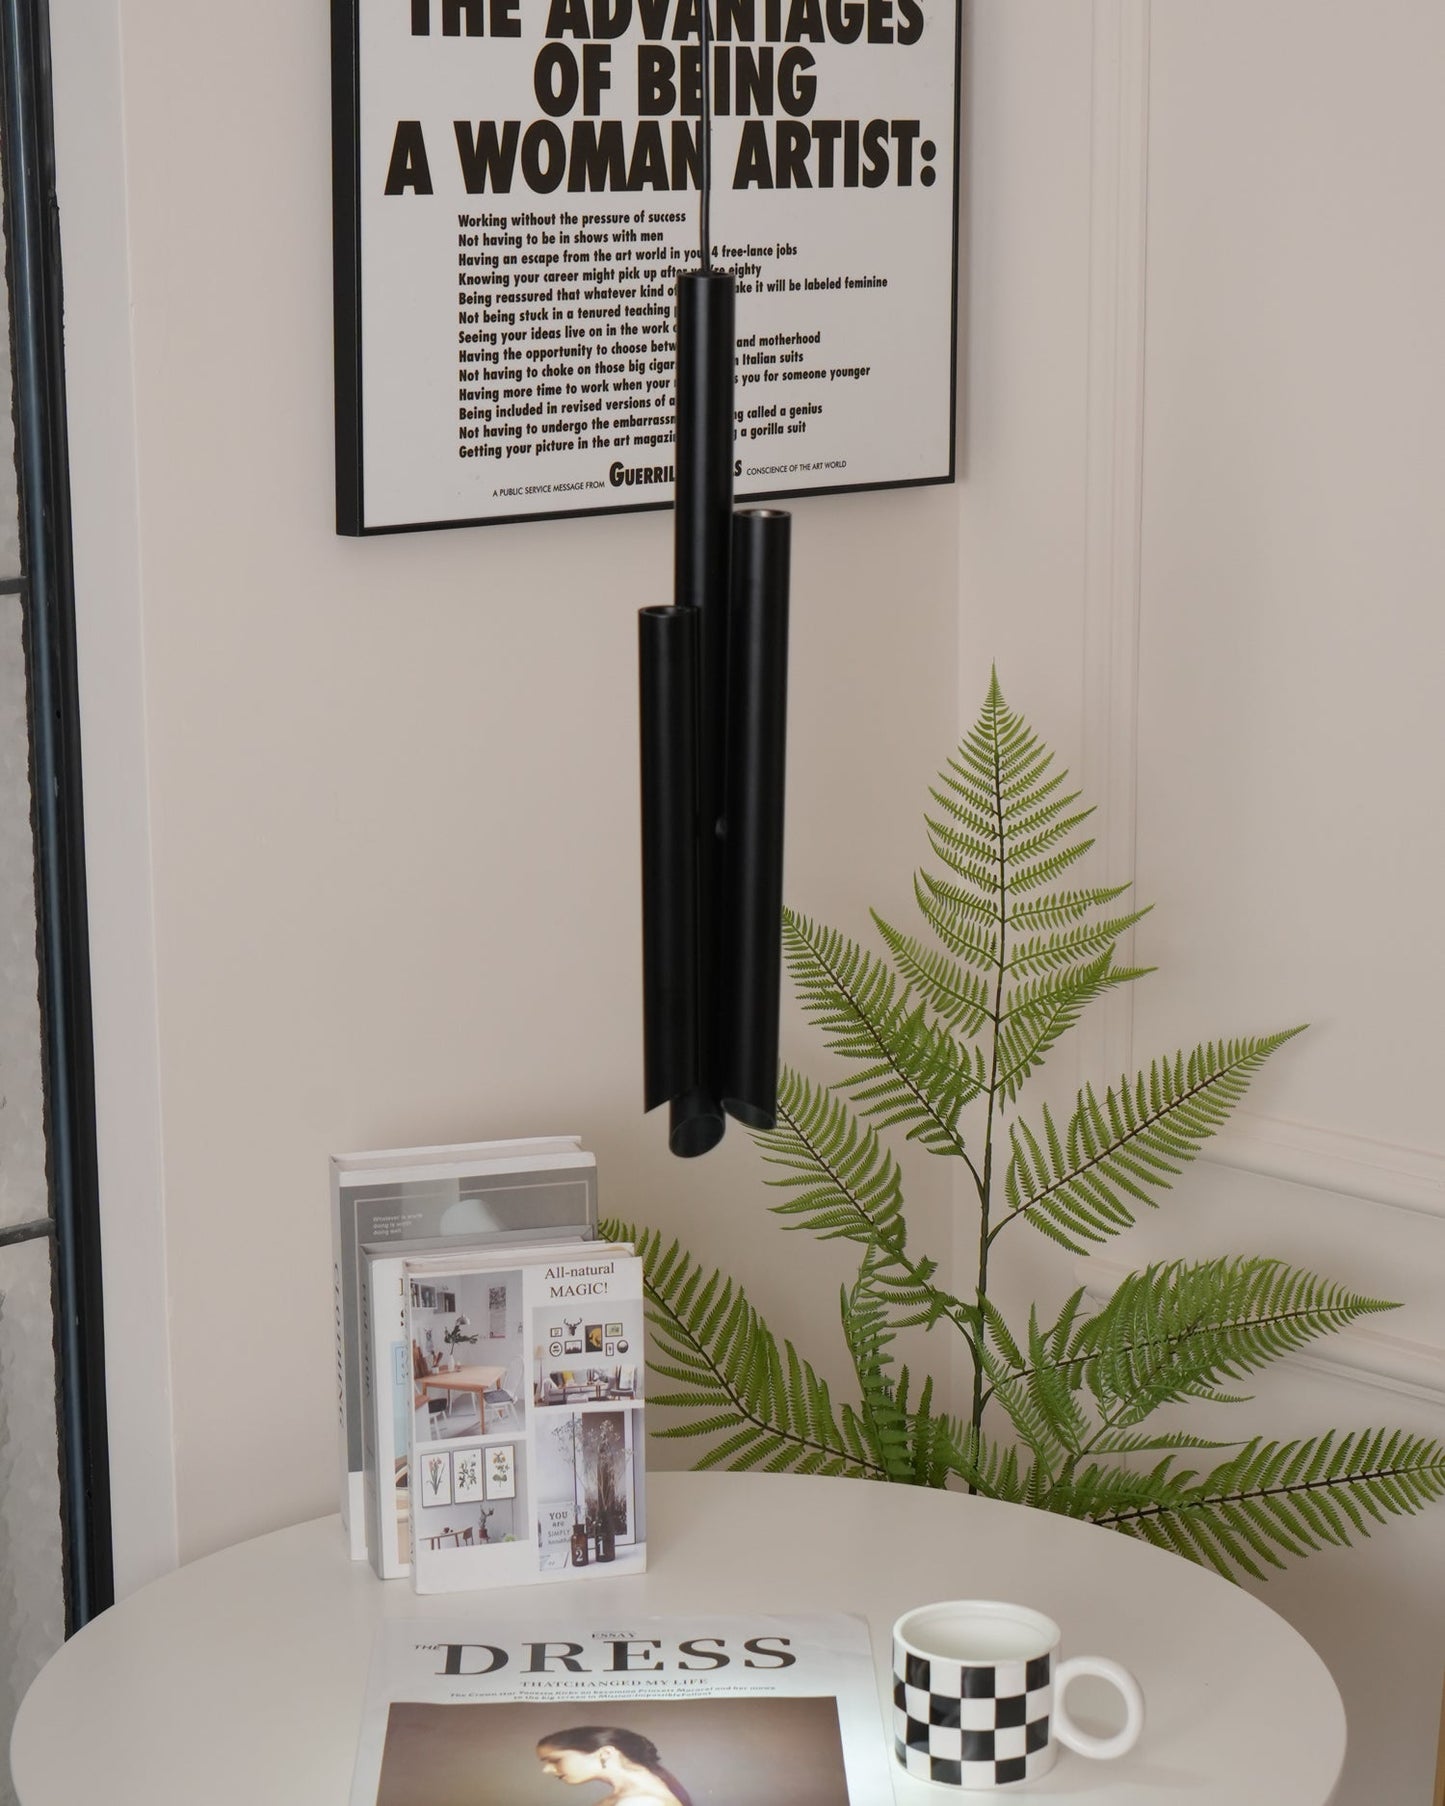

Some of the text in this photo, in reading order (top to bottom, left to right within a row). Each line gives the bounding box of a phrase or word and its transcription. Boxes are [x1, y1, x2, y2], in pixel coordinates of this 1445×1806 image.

[534, 42, 817, 117] OF BEING
[384, 119, 936, 196] A WOMAN ARTIST:
[458, 210, 686, 230] Working without the pressure of success
[459, 229, 663, 249] Not having to be in shows with men
[459, 252, 499, 269] Having
[503, 256, 517, 264] an
[521, 254, 559, 267] escape
[563, 250, 589, 262] from
[594, 249, 611, 261] the
[616, 250, 632, 261] art
[636, 247, 666, 260] world
[671, 247, 680, 259] in
[712, 246, 718, 257] 4
[722, 244, 773, 257] free-lance
[777, 243, 797, 259] jobs
[459, 271, 509, 287] Knowing
[514, 274, 539, 287] your
[544, 273, 578, 282] career
[583, 268, 615, 284] might
[619, 267, 640, 283] pick
[644, 270, 657, 282] up
[660, 265, 687, 278] aft
[729, 263, 762, 278] eighty
[459, 291, 491, 307] Being
[496, 288, 552, 303] reassured
[557, 288, 580, 301] that
[584, 287, 636, 299] whatever
[640, 284, 664, 297] kind
[735, 281, 752, 294] ake
[756, 280, 763, 292] it
[767, 279, 785, 292] will
[789, 279, 801, 291] be
[805, 277, 841, 290] labeled
[845, 276, 887, 288] feminine
[459, 312, 479, 324] Not
[483, 310, 515, 325] being
[520, 308, 548, 321] stuck
[553, 307, 563, 320] in
[567, 311, 573, 319] a
[578, 304, 620, 318] tenured
[625, 303, 670, 318] teaching
[459, 330, 497, 345] Seeing
[501, 332, 527, 345] your
[531, 327, 561, 339] ideas
[565, 325, 585, 338] live
[589, 328, 602, 337] on
[607, 324, 616, 336] in
[620, 323, 638, 335] the
[642, 321, 669, 334] work
[459, 331, 820, 364] Having the opportunity to choose betw and motherhood
[459, 370, 479, 382] Not
[484, 366, 522, 382] having
[527, 367, 538, 378] to
[542, 363, 573, 377] choke
[578, 366, 591, 375] on
[595, 361, 625, 374] those
[629, 359, 645, 375] big
[649, 359, 676, 372] cigar
[743, 352, 776, 365] Italian
[780, 350, 803, 363] suits
[459, 389, 499, 402] Having
[504, 388, 532, 398] more
[537, 383, 562, 396] time
[566, 384, 577, 394] to
[581, 379, 609, 393] work
[613, 378, 642, 391] when
[646, 380, 670, 392] your
[742, 374, 760, 386] you
[764, 370, 779, 381] for
[782, 370, 826, 381] someone
[830, 367, 870, 381] younger
[459, 427, 479, 439] Not
[484, 423, 522, 438] having
[526, 424, 537, 434] to
[542, 420, 587, 434] undergo
[592, 417, 609, 429] the
[613, 414, 676, 428] embarrass
[747, 405, 776, 418] called
[780, 408, 786, 416] a
[790, 402, 822, 419] genius
[460, 406, 491, 422] Being
[496, 402, 542, 417] included
[547, 402, 557, 414] in
[562, 398, 602, 413] revised
[606, 396, 651, 410] versions
[655, 394, 665, 407] of
[459, 444, 502, 459] Getting
[506, 445, 531, 458] your
[536, 439, 574, 456] picture
[578, 437, 588, 449] in
[592, 435, 610, 448] the
[614, 435, 630, 446] art
[633, 430, 676, 447] magazi
[741, 429, 747, 437] a
[751, 423, 783, 439] gorilla
[788, 421, 806, 433] suit
[500, 487, 523, 496] PUBLIC
[525, 485, 551, 494] SERVICE
[553, 482, 583, 492] MESSAGE
[585, 481, 605, 489] FROM
[609, 461, 676, 487] GUERRIL
[747, 465, 787, 475] CONSCIENCE
[545, 1262, 615, 1280] All-natural
[550, 1282, 608, 1298] MAGIC!
[549, 1511, 568, 1520] YOU
[575, 1548, 584, 1562] 2
[597, 1539, 605, 1556] 1
[434, 1637, 797, 1675] DRESS
